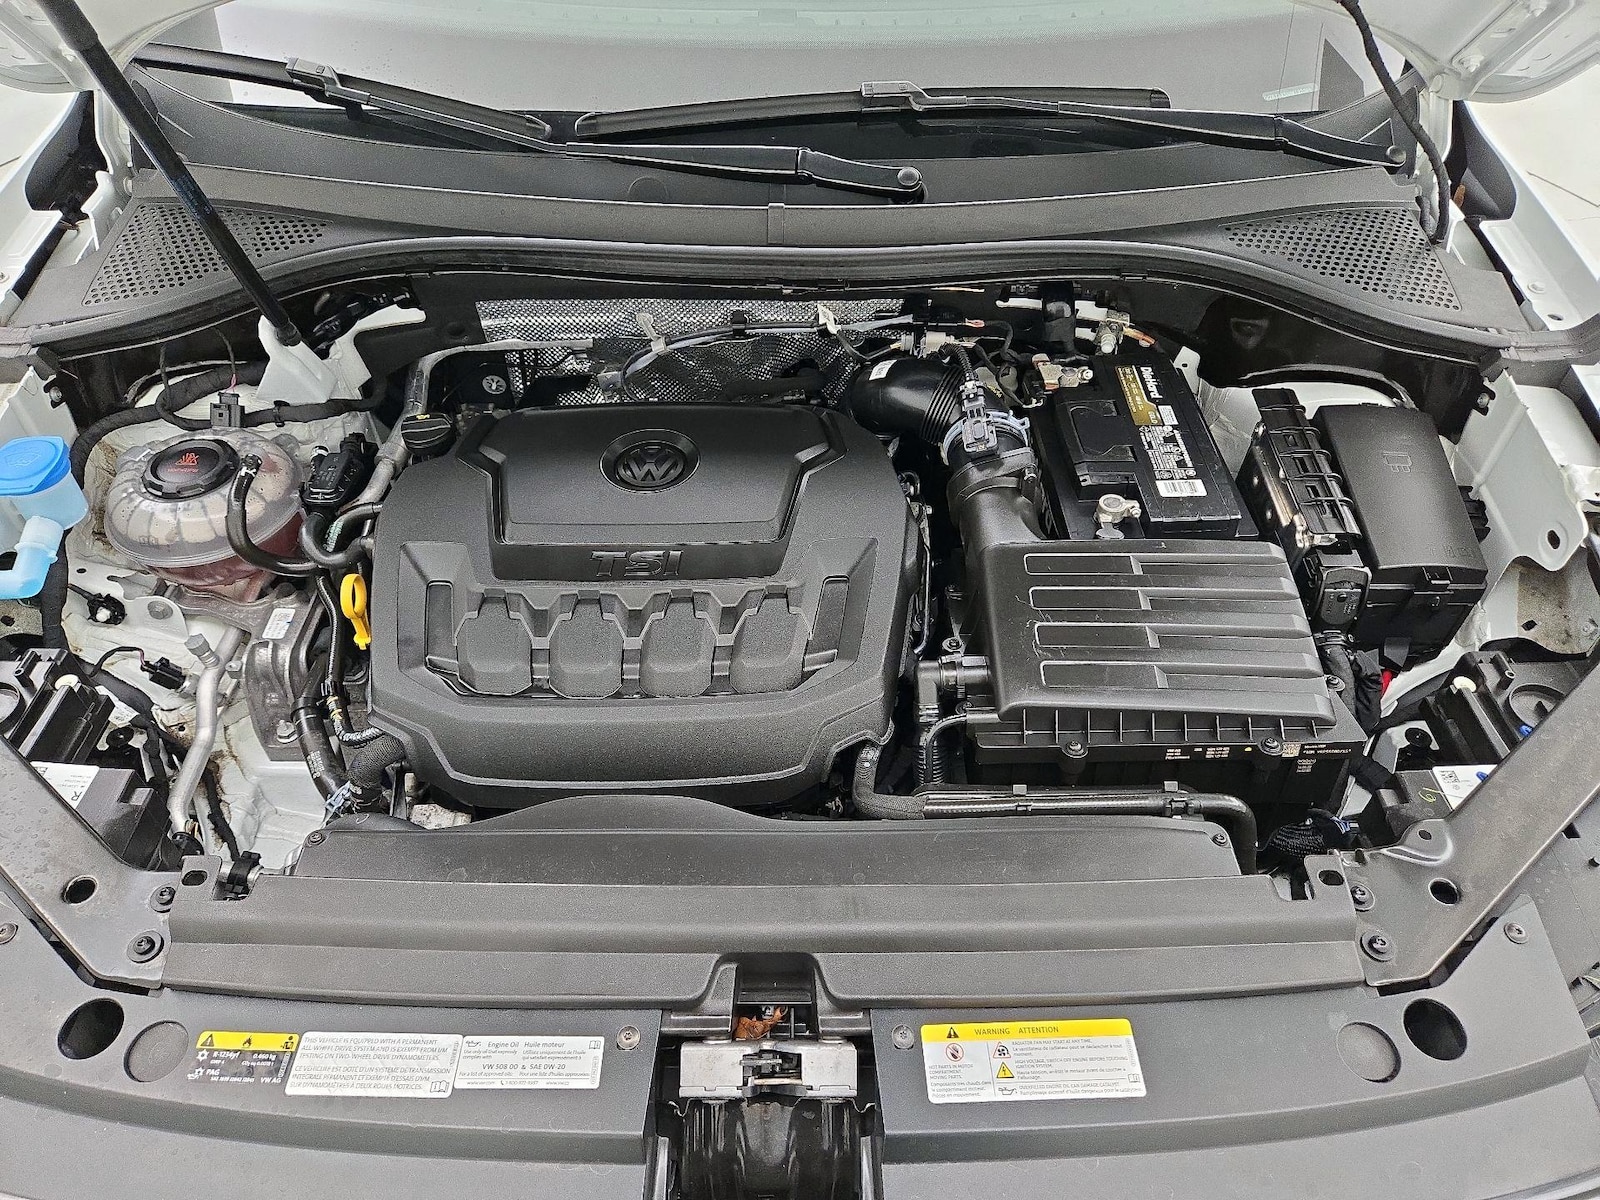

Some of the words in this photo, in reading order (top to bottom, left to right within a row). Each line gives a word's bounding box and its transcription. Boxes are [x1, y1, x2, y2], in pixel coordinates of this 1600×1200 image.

[1140, 367, 1163, 399] DieHard
[590, 551, 684, 577] TSI
[974, 1027, 1010, 1035] WARNING
[1018, 1026, 1059, 1034] ATTENTION
[488, 1041, 509, 1049] Engine
[212, 1051, 241, 1060] R-1234yf
